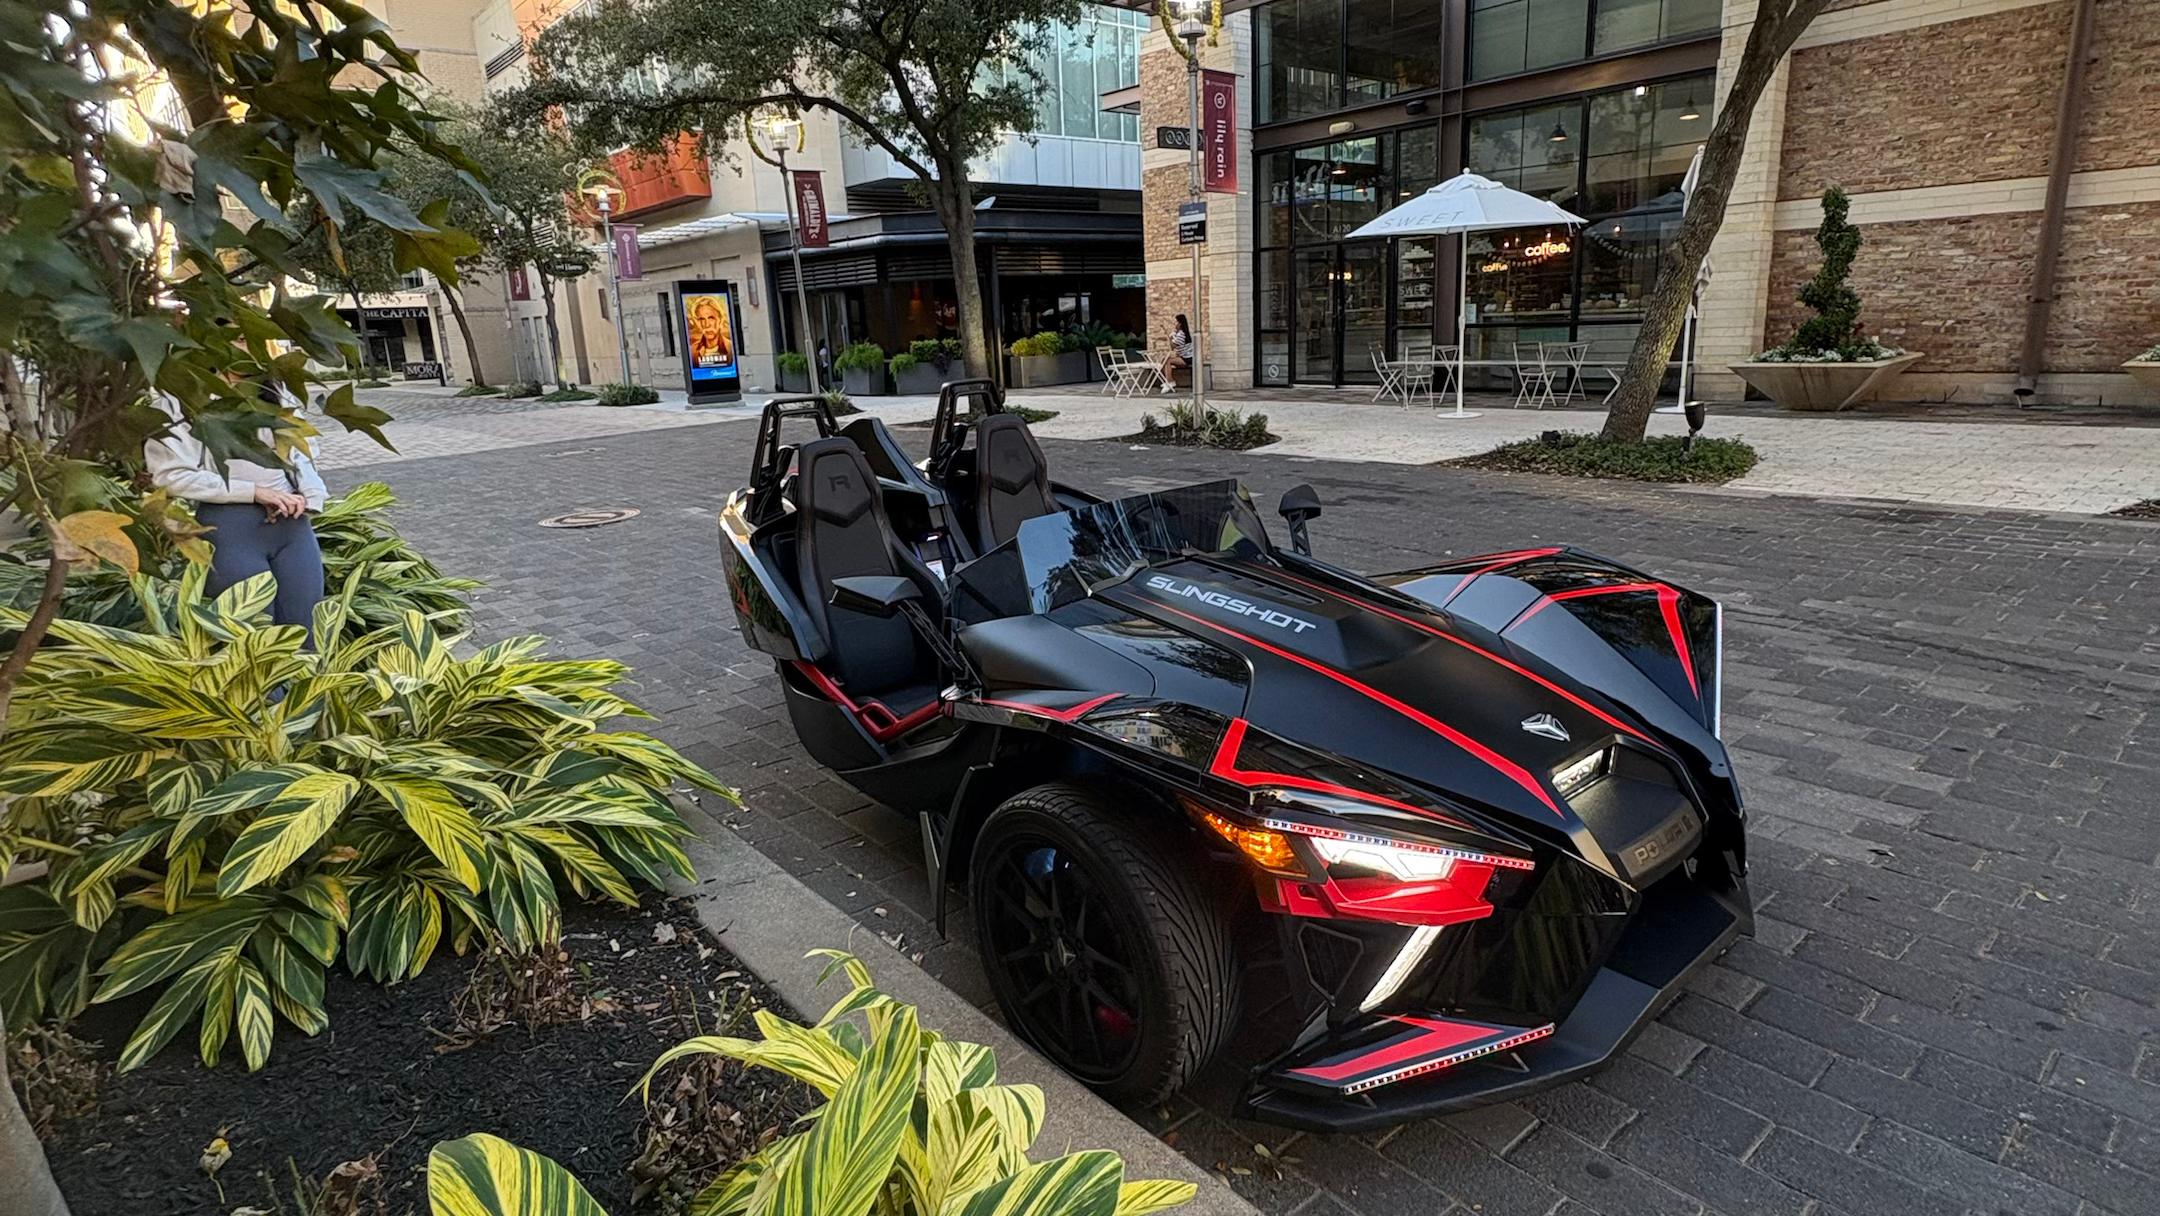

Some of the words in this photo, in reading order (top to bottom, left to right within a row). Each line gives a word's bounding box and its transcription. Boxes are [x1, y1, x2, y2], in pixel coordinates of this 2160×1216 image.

[1214, 119, 1226, 143] lily
[1217, 146, 1226, 178] rain
[1381, 210, 1463, 229] SWEET
[1146, 576, 1316, 633] SLINGSHOT
